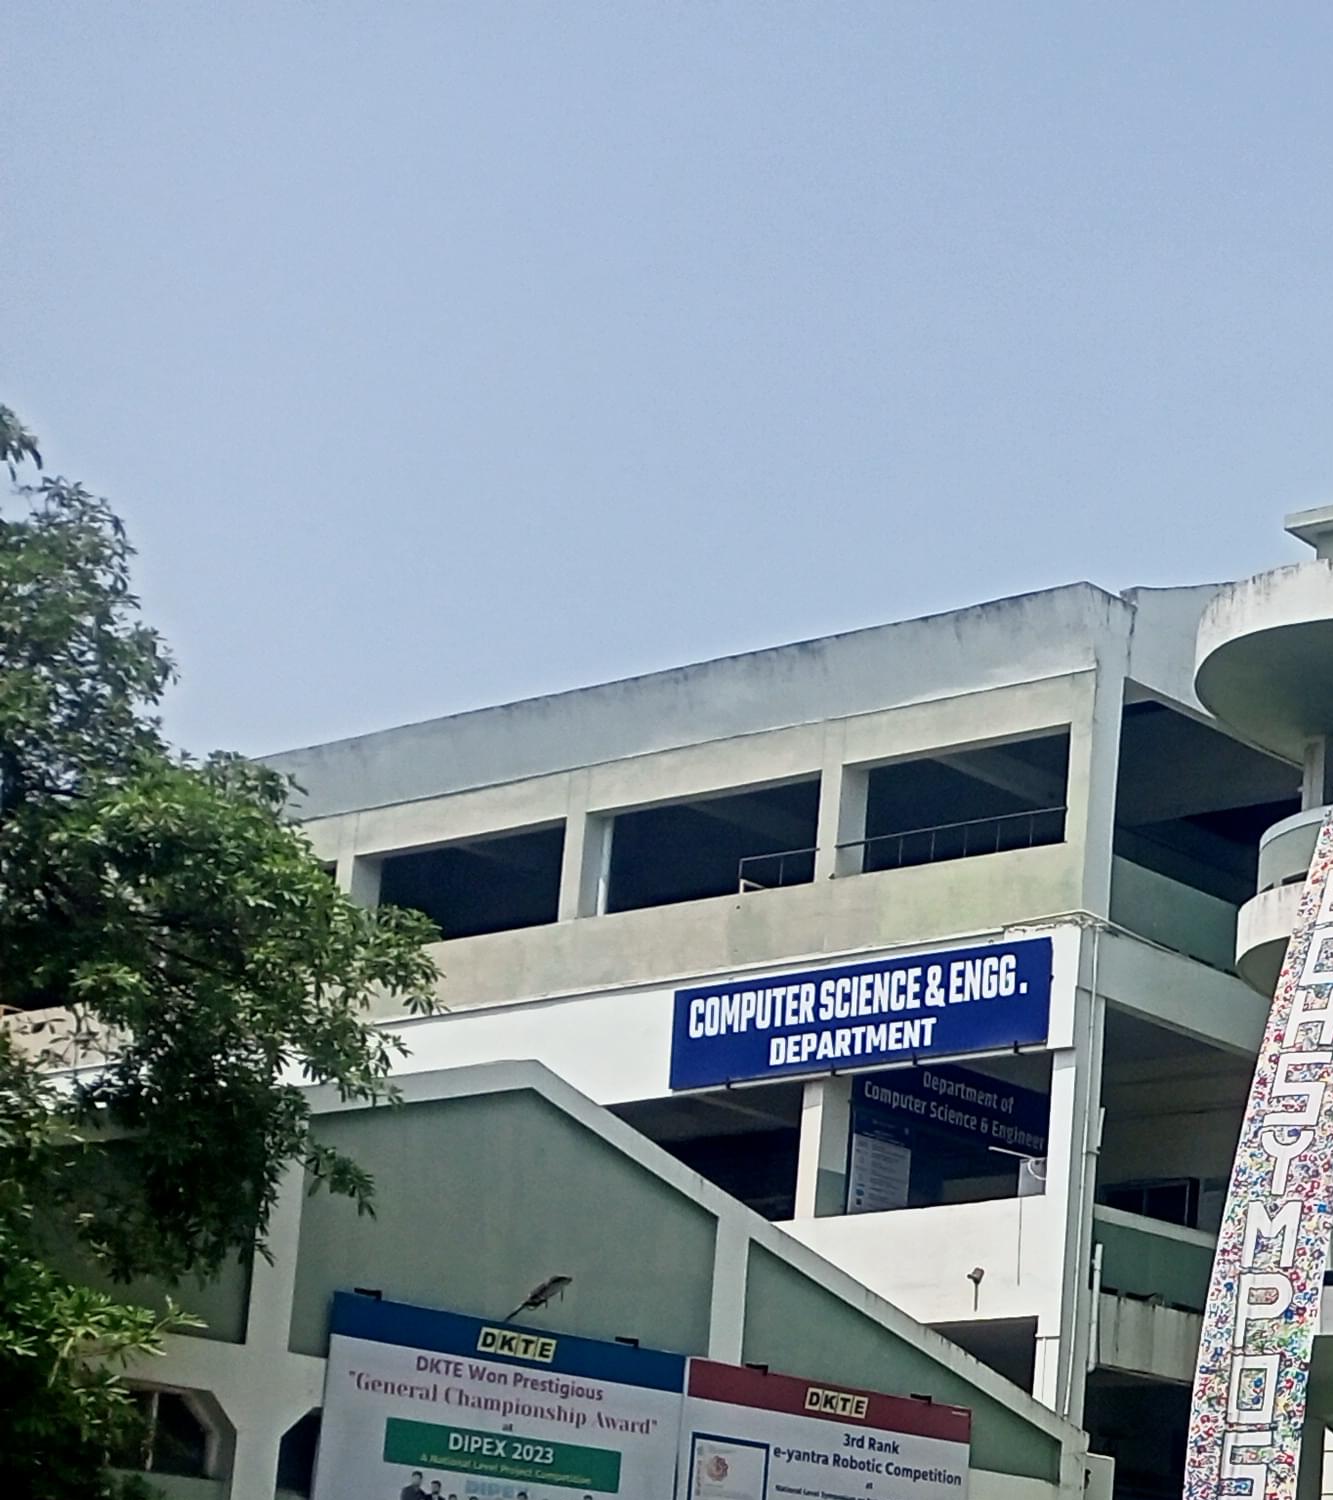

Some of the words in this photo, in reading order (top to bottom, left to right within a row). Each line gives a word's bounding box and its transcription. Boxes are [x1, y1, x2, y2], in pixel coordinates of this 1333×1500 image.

[689, 983, 815, 1038] COMPUTER
[819, 965, 920, 1020] SCIENCE
[925, 968, 946, 1007] &
[948, 955, 1028, 1004] ENGG.
[769, 1016, 936, 1066] DEPARTMENT
[923, 1071, 997, 1109] Department
[1001, 1097, 1014, 1114] of
[865, 1081, 927, 1114] Computer
[930, 1102, 977, 1130] Science
[981, 1118, 988, 1133] &
[992, 1120, 1045, 1150] Engineer
[416, 1356, 463, 1378] DKTE
[468, 1365, 508, 1385] Won
[513, 1373, 603, 1401] Prestigious
[350, 1370, 437, 1401] "General
[445, 1388, 586, 1428] Championship
[596, 1412, 657, 1435] Award"
[449, 1434, 506, 1459] DIPEX
[512, 1443, 554, 1464] 2023
[774, 1445, 828, 1465] e-yantra
[833, 1457, 881, 1474] Robotic
[885, 1463, 961, 1486] Competition
[843, 1434, 864, 1449] 3rd
[868, 1437, 899, 1454] Rank
